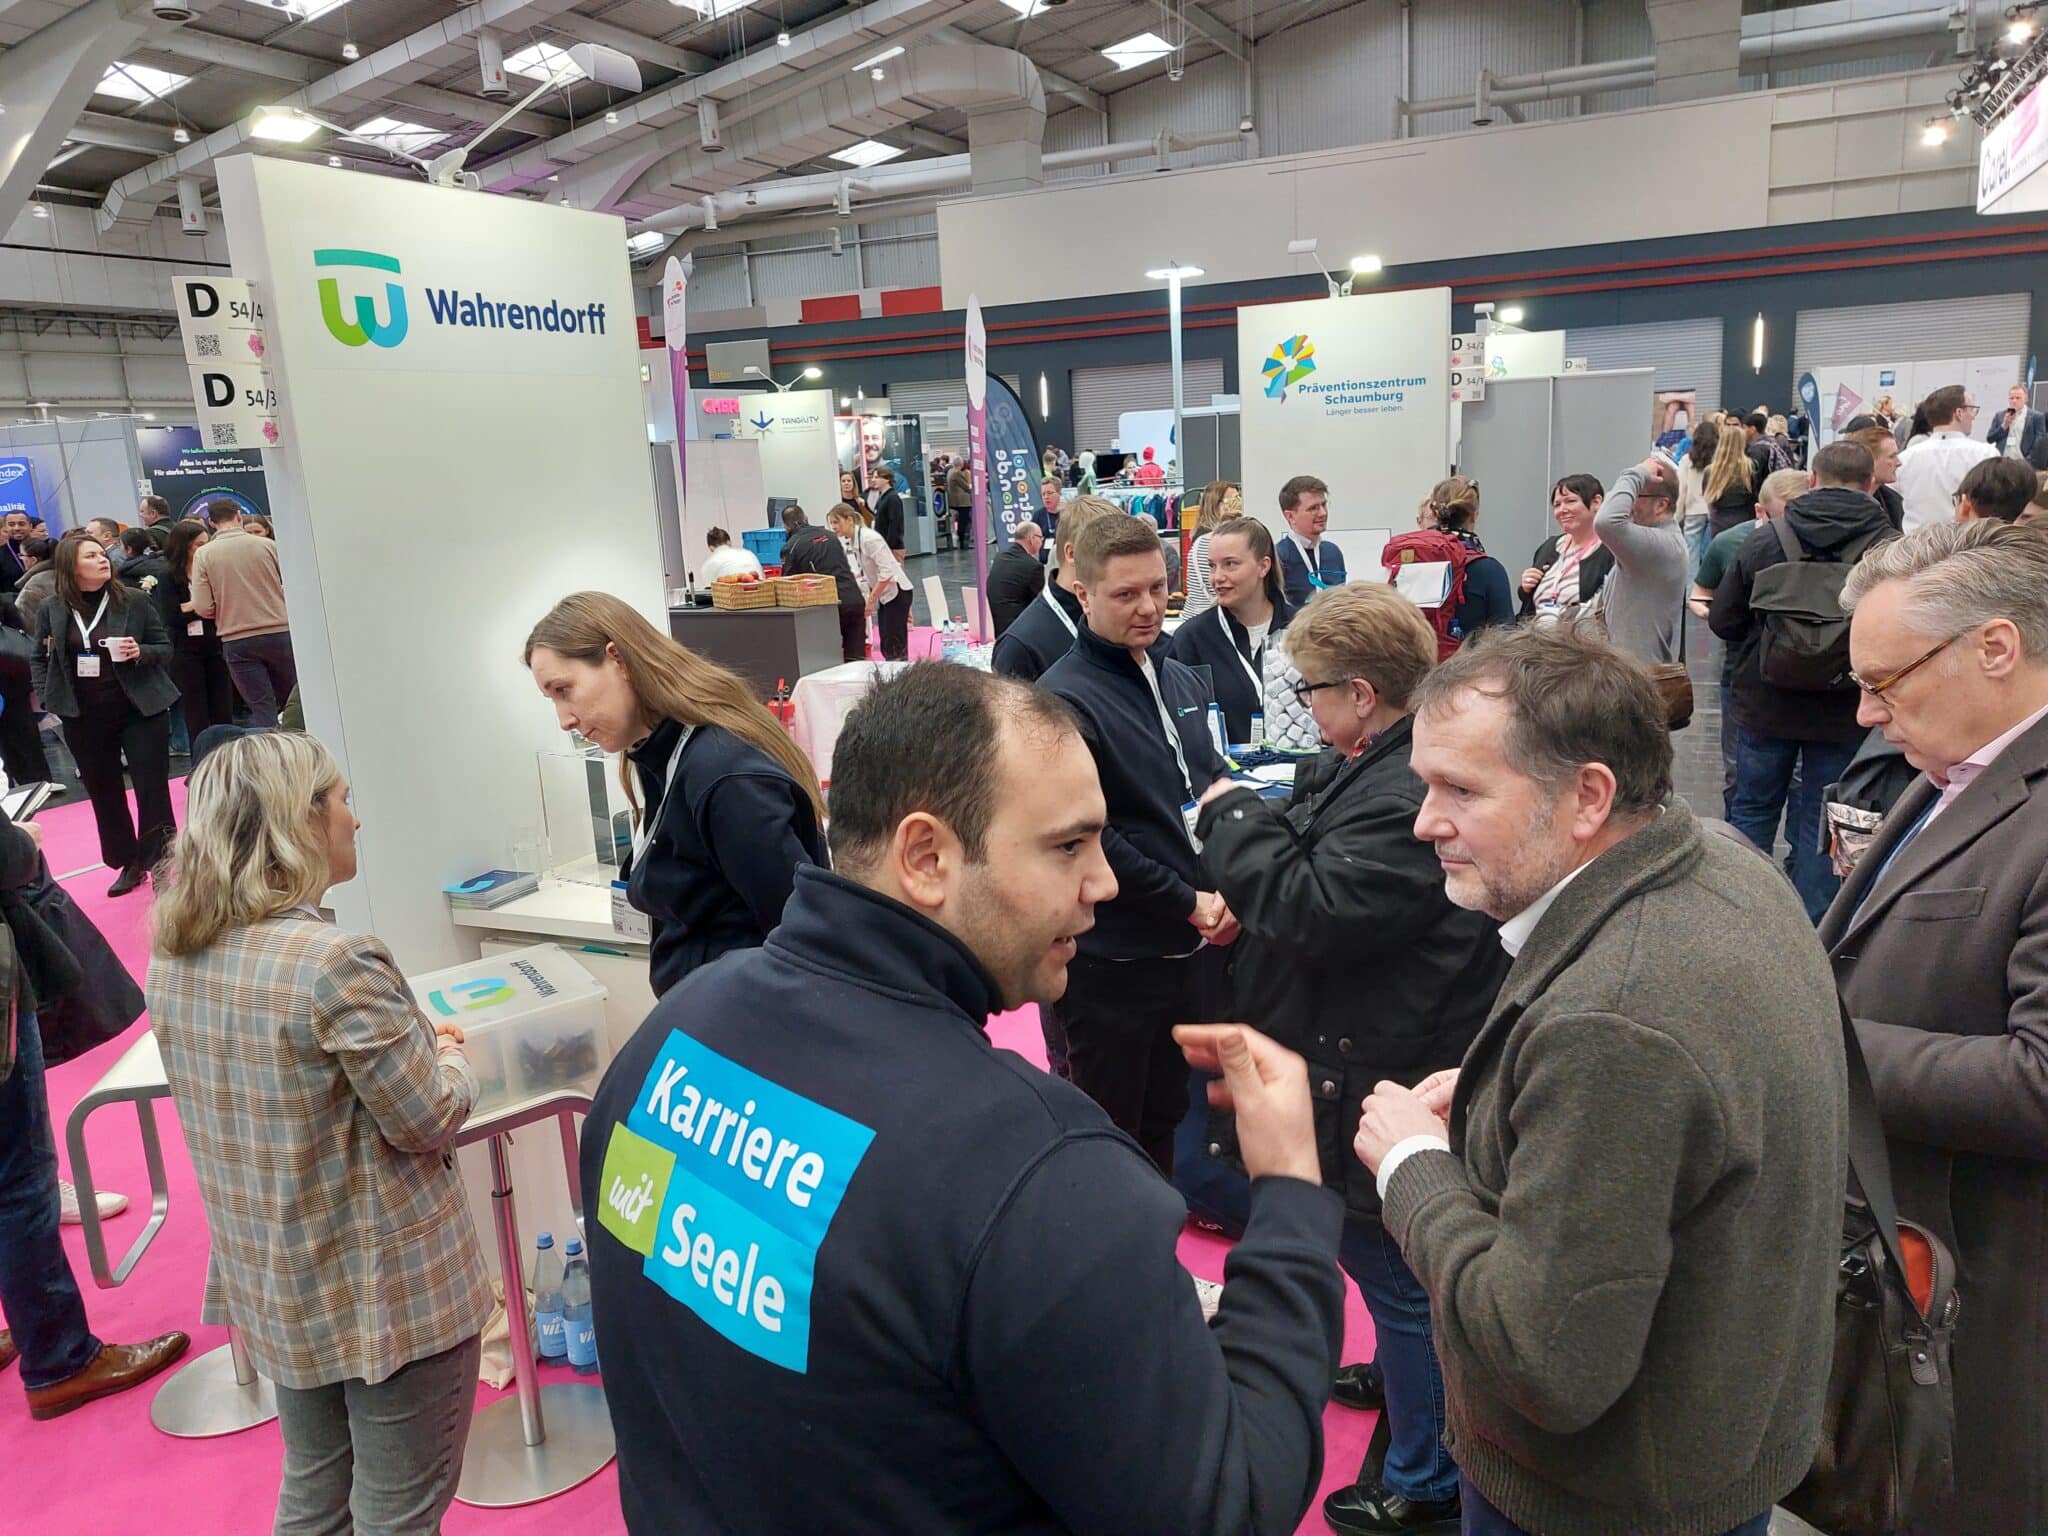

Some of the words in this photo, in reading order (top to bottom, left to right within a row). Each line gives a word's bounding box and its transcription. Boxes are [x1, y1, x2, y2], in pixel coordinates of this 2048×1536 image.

[186, 283, 219, 318] D
[229, 301, 264, 322] 54/4
[425, 288, 605, 335] Wahrendorff
[1451, 337, 1463, 351] D
[1298, 376, 1427, 394] Präventionszentrum
[1451, 372, 1462, 386] D
[202, 373, 235, 407] D
[246, 389, 277, 410] 54/3
[1325, 391, 1404, 405] Schaumburg
[1326, 407, 1352, 417] Länger
[1353, 406, 1379, 414] besser
[180, 458, 194, 466] Alles
[206, 466, 235, 474] Sicherheit
[235, 465, 247, 473] und
[646, 1058, 825, 1208] Karriere
[608, 1172, 655, 1225] mit
[662, 1203, 786, 1333] Seele
